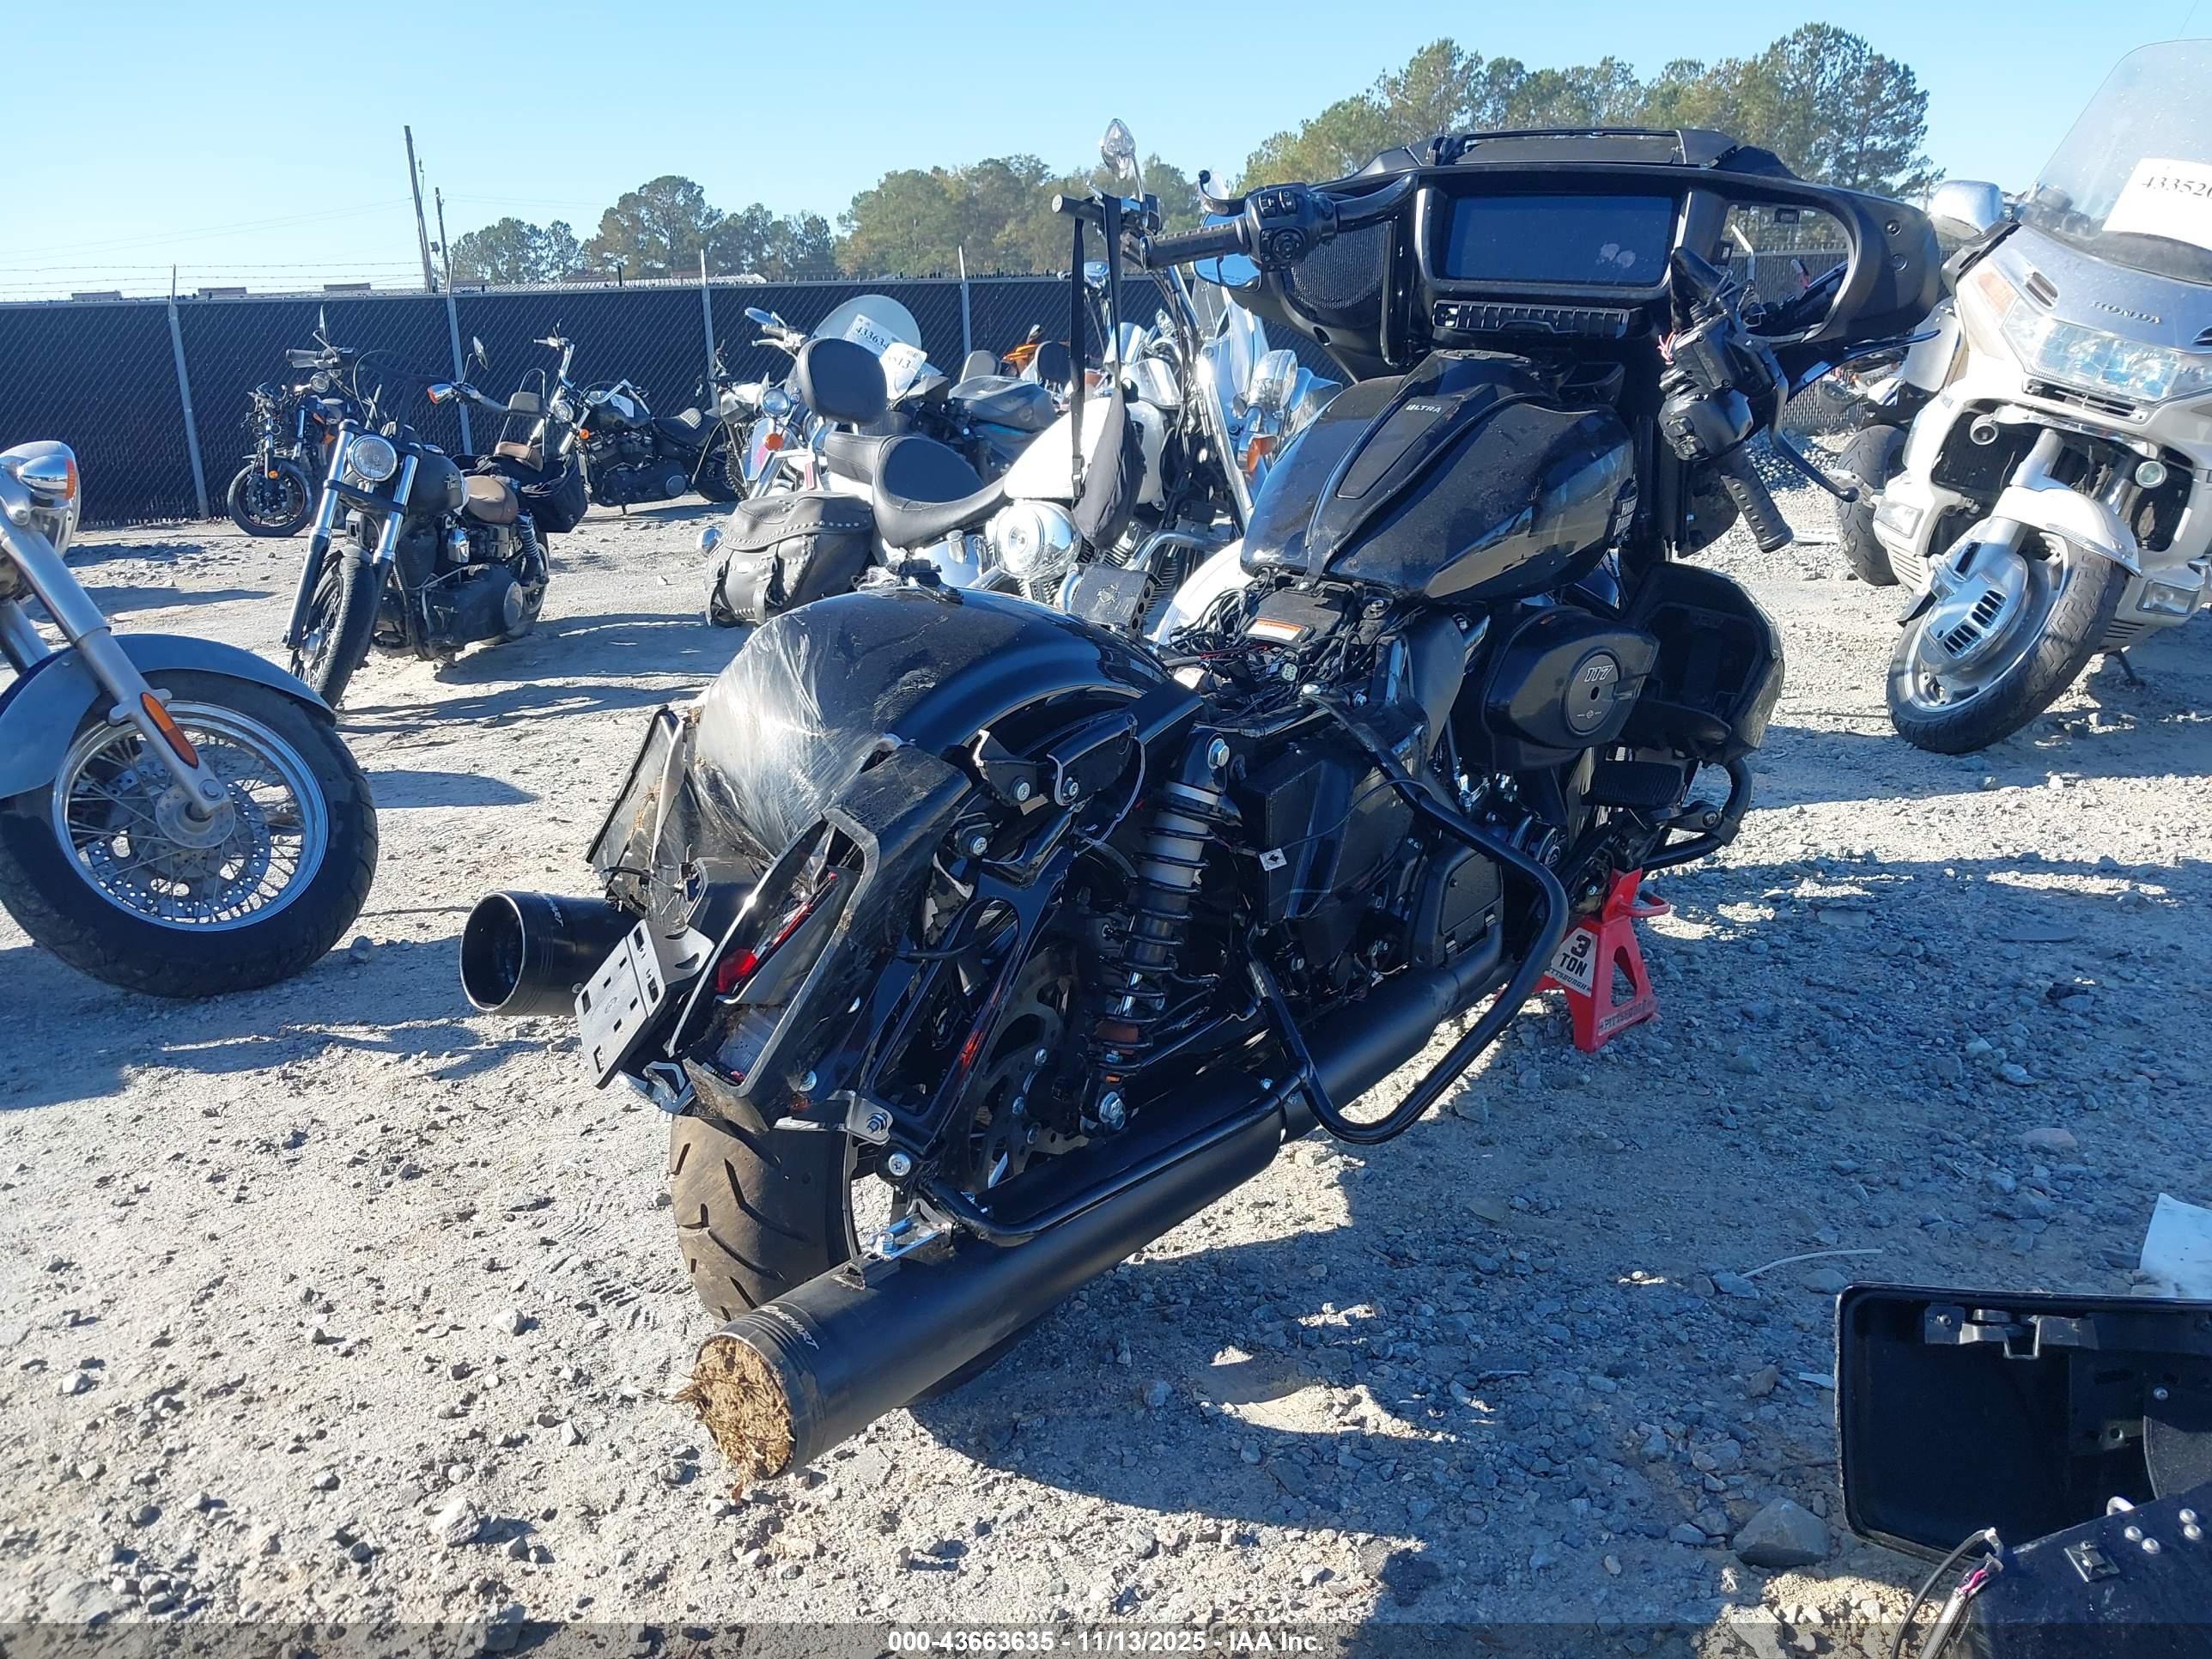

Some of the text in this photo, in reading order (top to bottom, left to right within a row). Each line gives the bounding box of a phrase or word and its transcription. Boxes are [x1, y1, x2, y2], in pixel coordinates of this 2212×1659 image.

[2089, 301, 2160, 324] HONDA
[1406, 404, 1443, 413] ULTRA
[1584, 665, 1613, 683] 117
[1571, 934, 1592, 958] 3
[1559, 952, 1588, 977] TON
